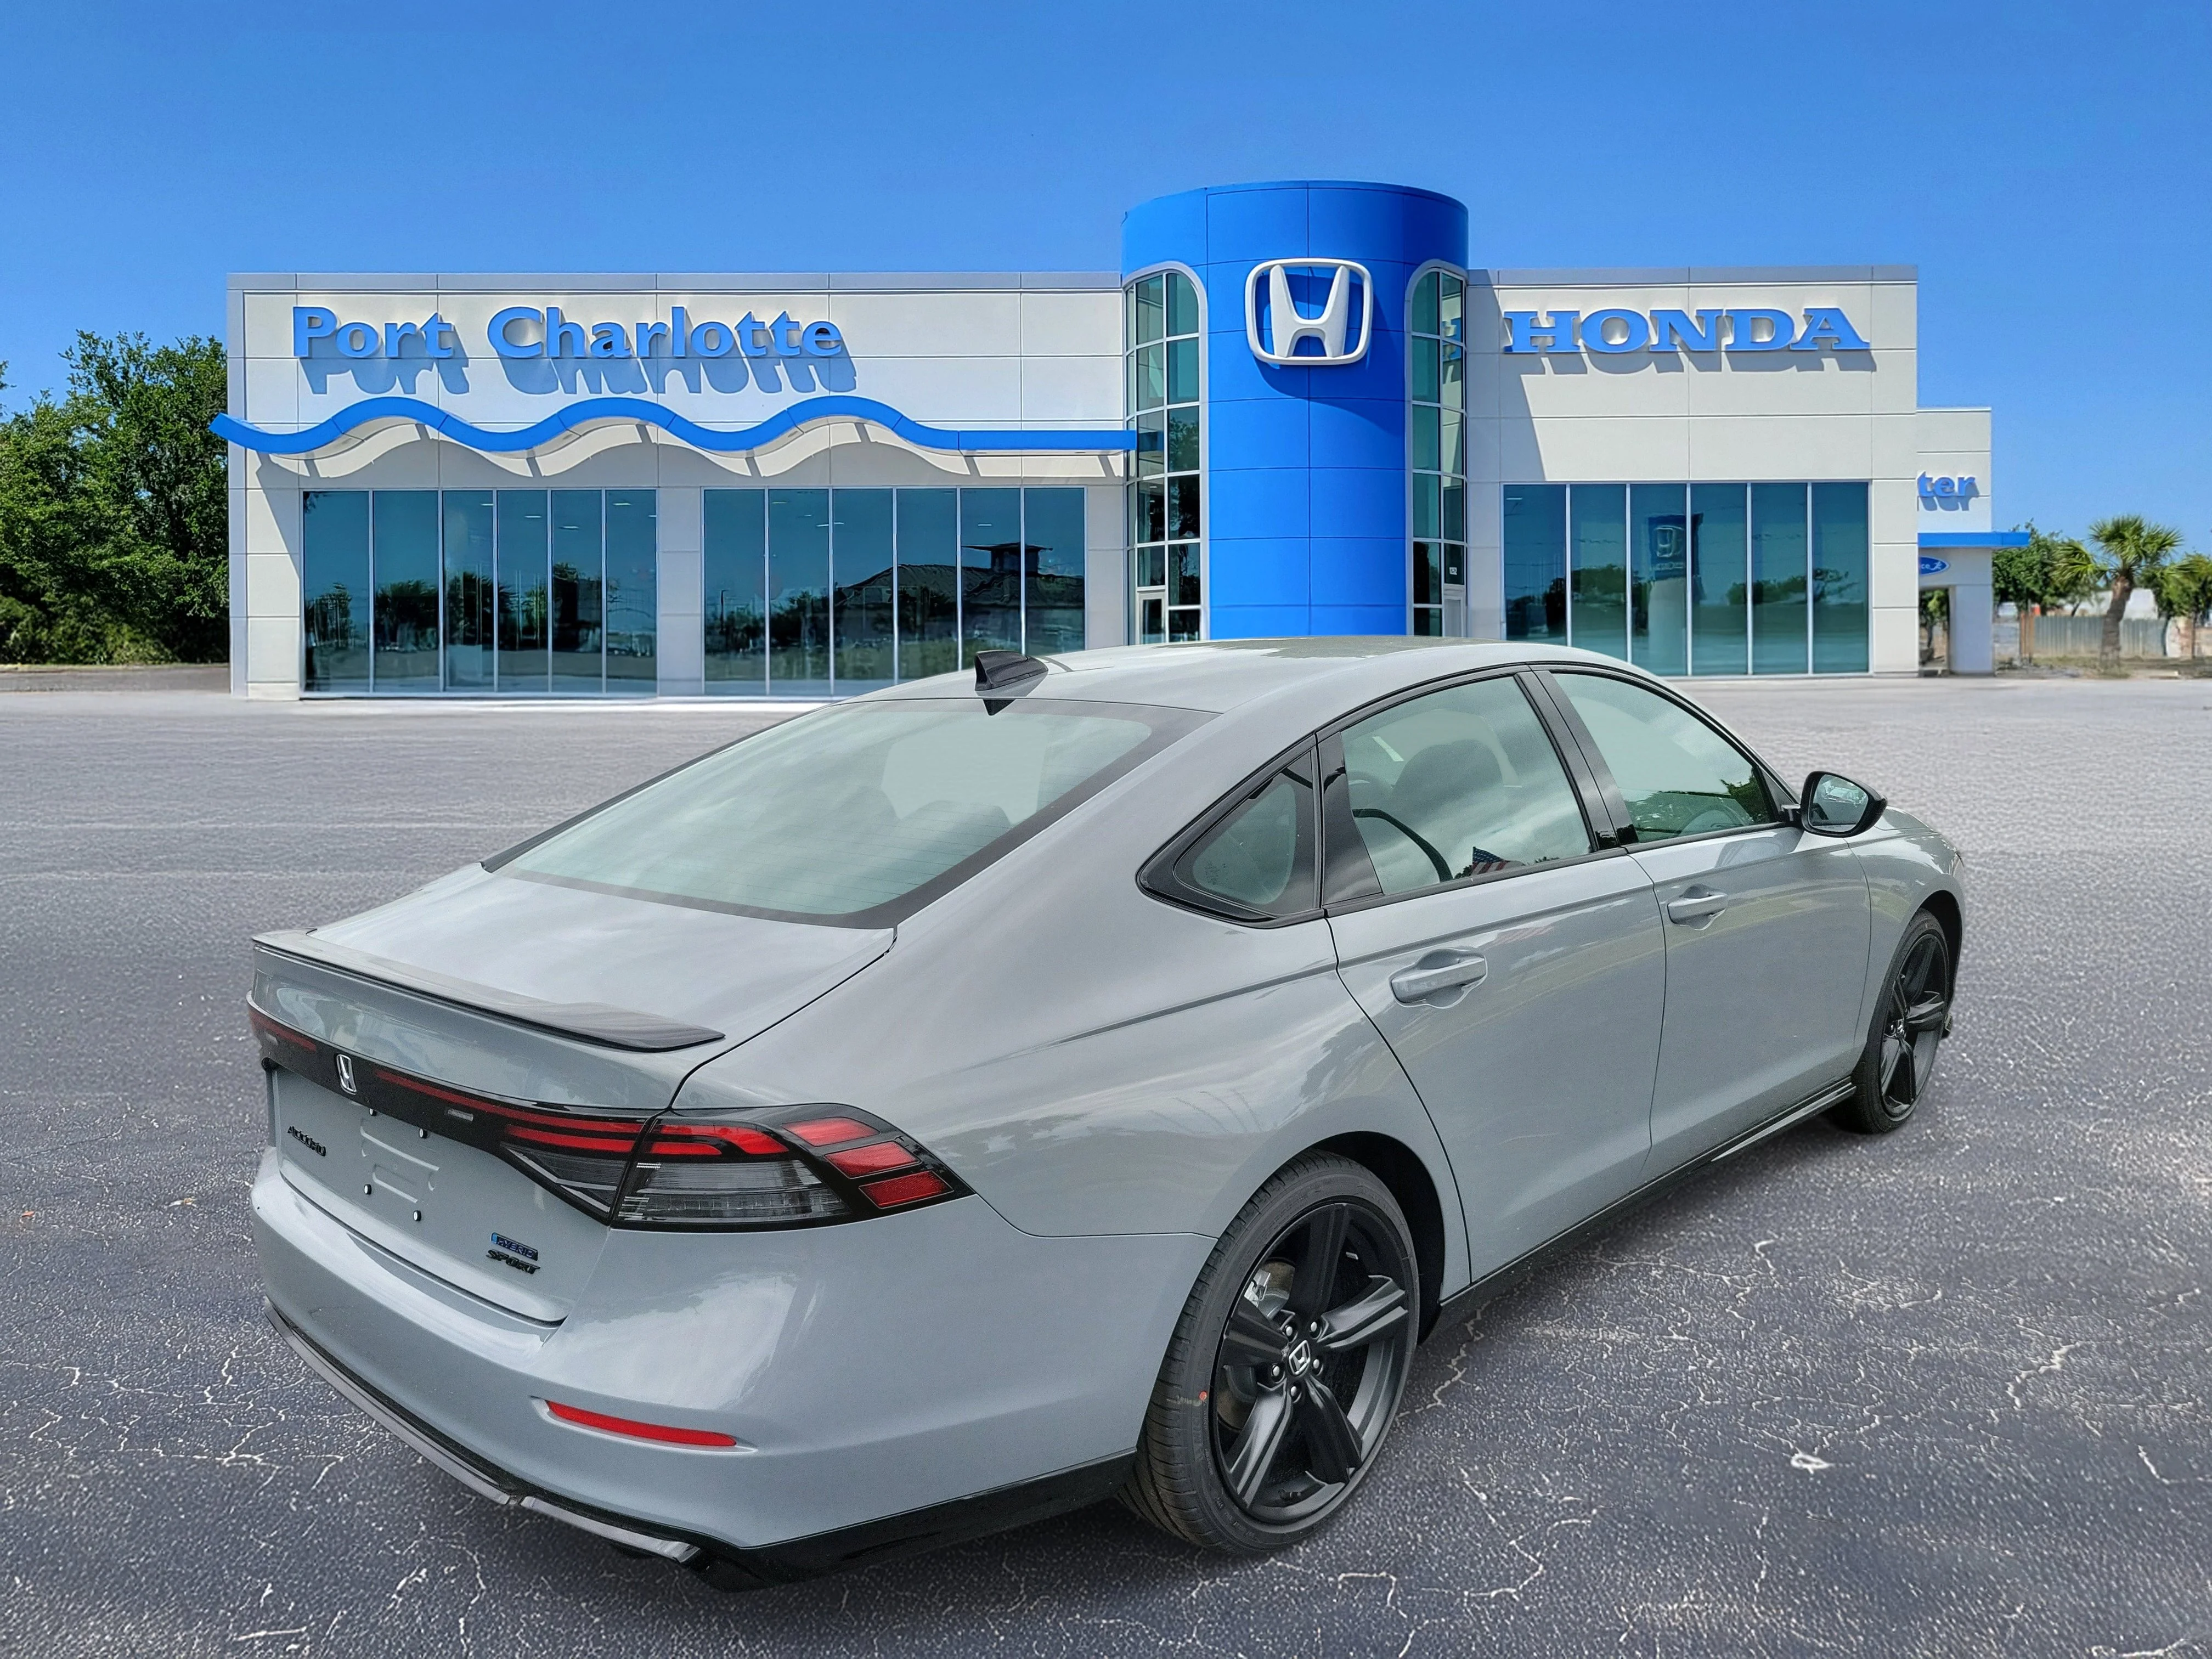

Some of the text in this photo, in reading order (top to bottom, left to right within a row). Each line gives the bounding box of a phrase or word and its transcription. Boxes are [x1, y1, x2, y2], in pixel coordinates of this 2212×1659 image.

[292, 306, 841, 359] Port Charlotte
[1503, 308, 1870, 353] HONDA
[287, 1126, 326, 1156] ACCORD
[486, 1249, 540, 1274] SPORT
[497, 1236, 534, 1258] HYBRID
